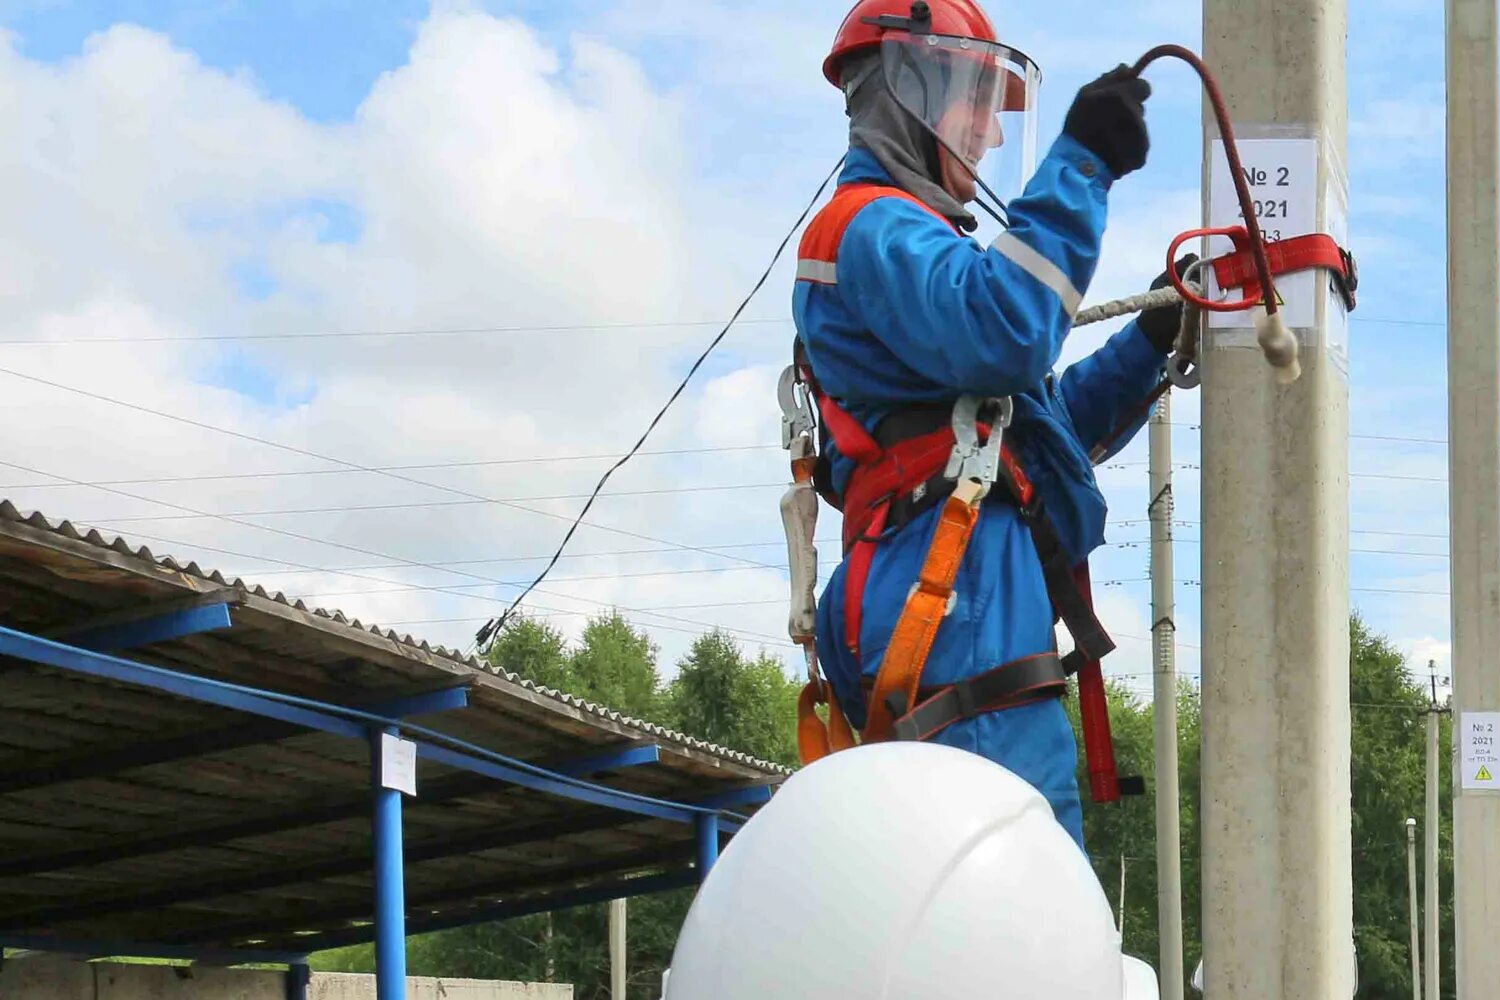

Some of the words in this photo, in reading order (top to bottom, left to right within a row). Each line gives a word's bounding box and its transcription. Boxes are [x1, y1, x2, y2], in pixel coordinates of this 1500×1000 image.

[1276, 166, 1290, 186] 2
[1238, 199, 1288, 218] 021
[1472, 723, 1484, 732] №
[1487, 723, 1493, 732] 2
[1472, 736, 1493, 745] 2021
